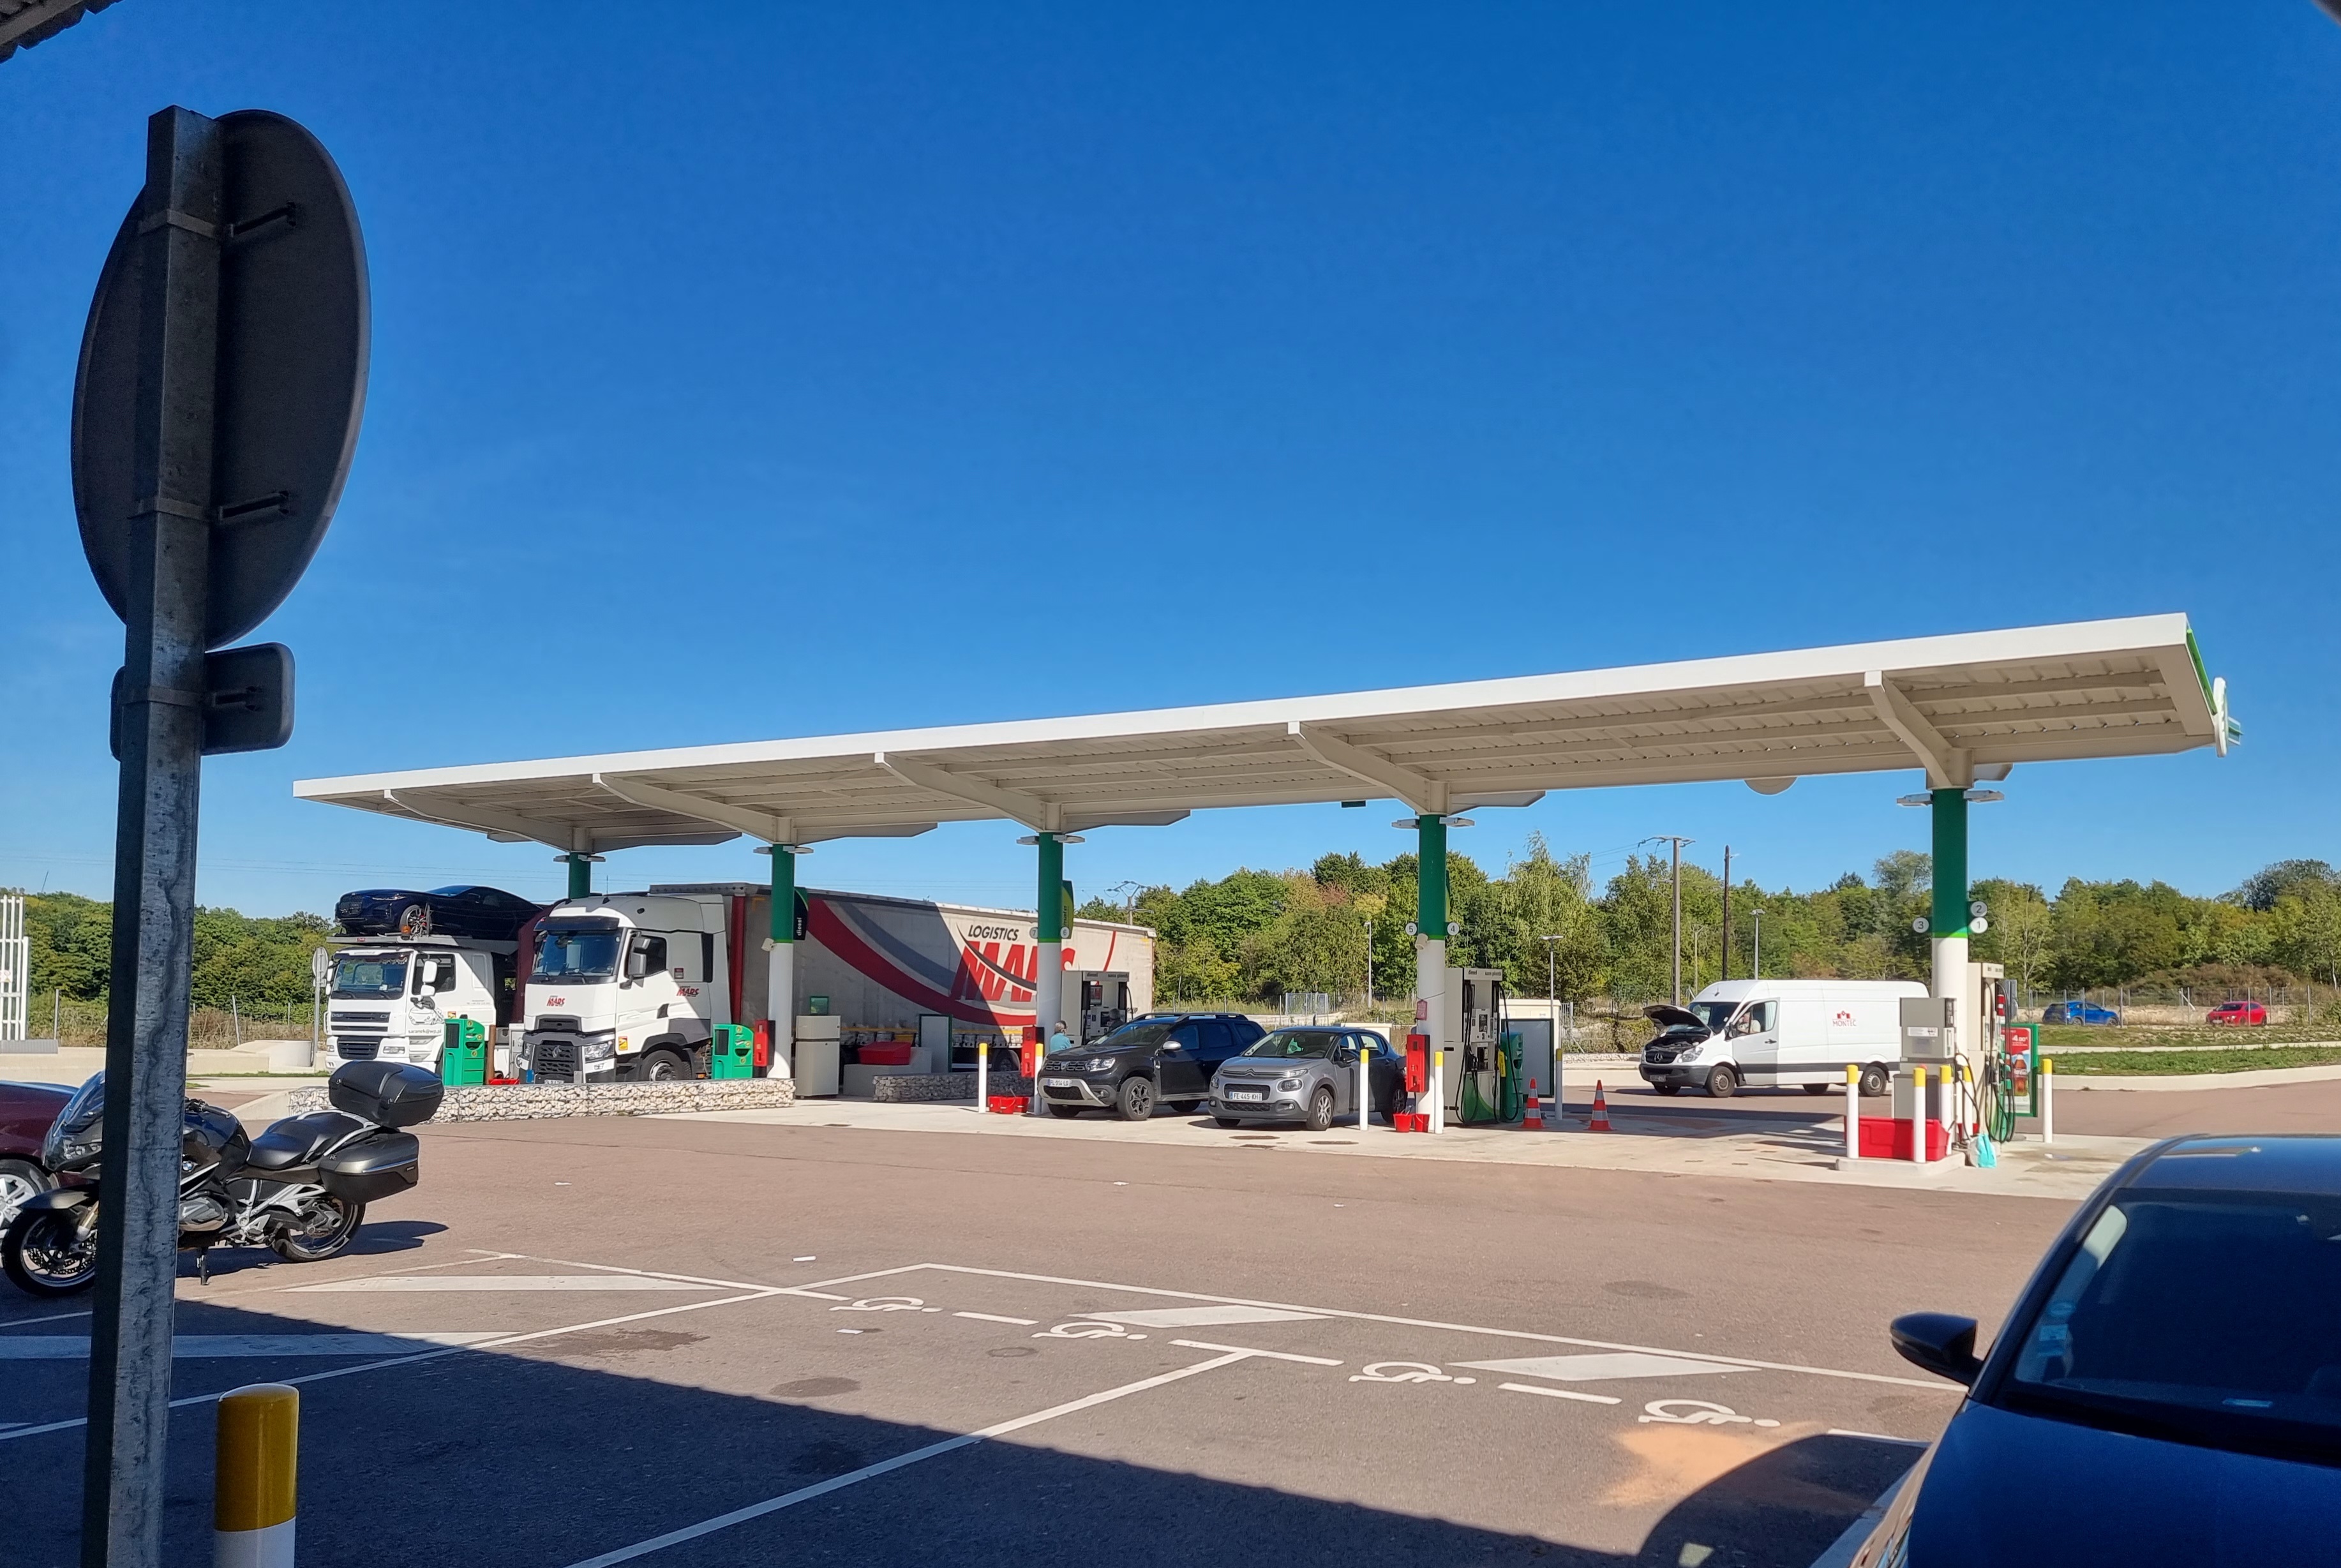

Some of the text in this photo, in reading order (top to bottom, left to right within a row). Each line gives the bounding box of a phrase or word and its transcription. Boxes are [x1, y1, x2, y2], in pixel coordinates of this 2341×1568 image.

[1976, 905, 1982, 913] 2
[1917, 921, 1924, 929] 3
[1977, 921, 1981, 929] 1
[968, 924, 1019, 941] LOGISTICS
[949, 941, 1075, 1002] MA
[676, 987, 699, 996] MARS
[546, 997, 565, 1006] MARS
